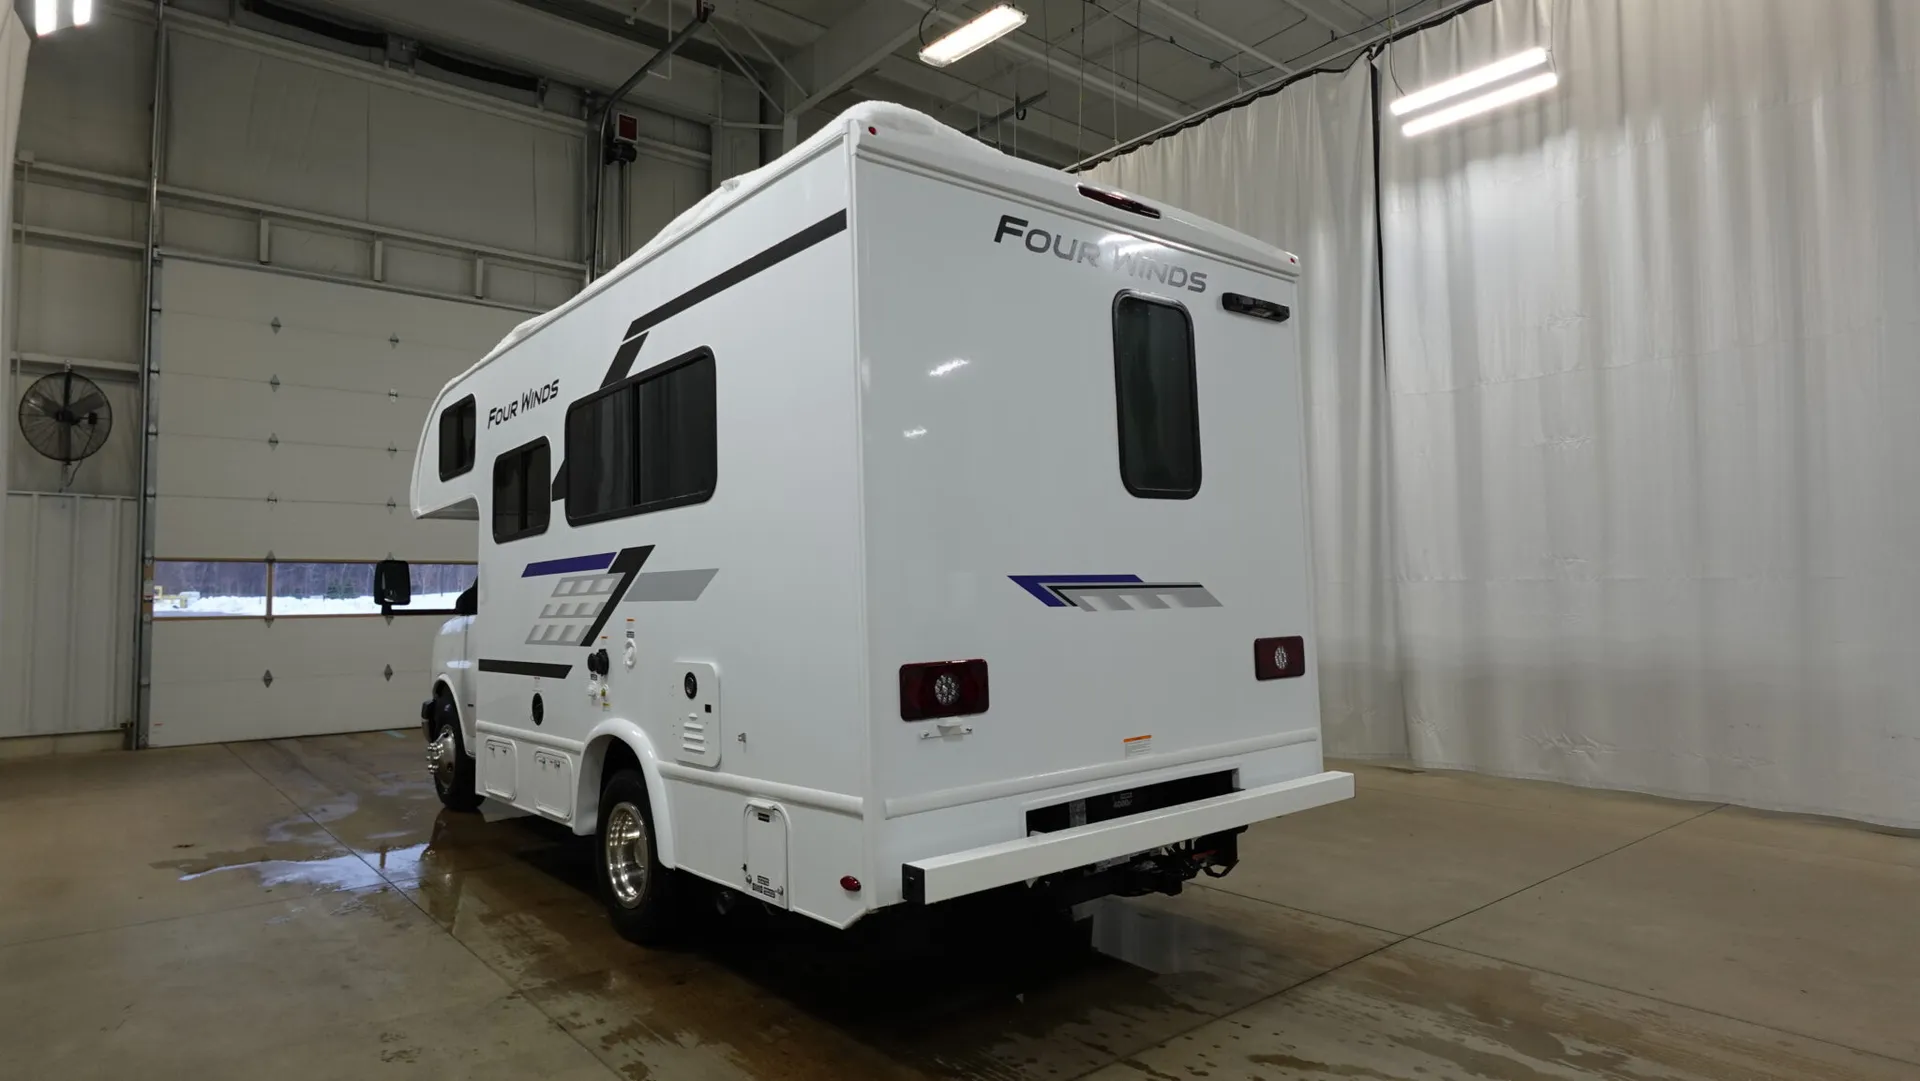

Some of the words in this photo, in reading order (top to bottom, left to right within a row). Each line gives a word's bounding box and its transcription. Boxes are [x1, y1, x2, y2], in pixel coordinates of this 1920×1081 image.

[994, 214, 1100, 267] FOUR
[1112, 245, 1207, 293] WINDS
[488, 400, 518, 429] FOUR
[521, 379, 559, 413] WINDS
